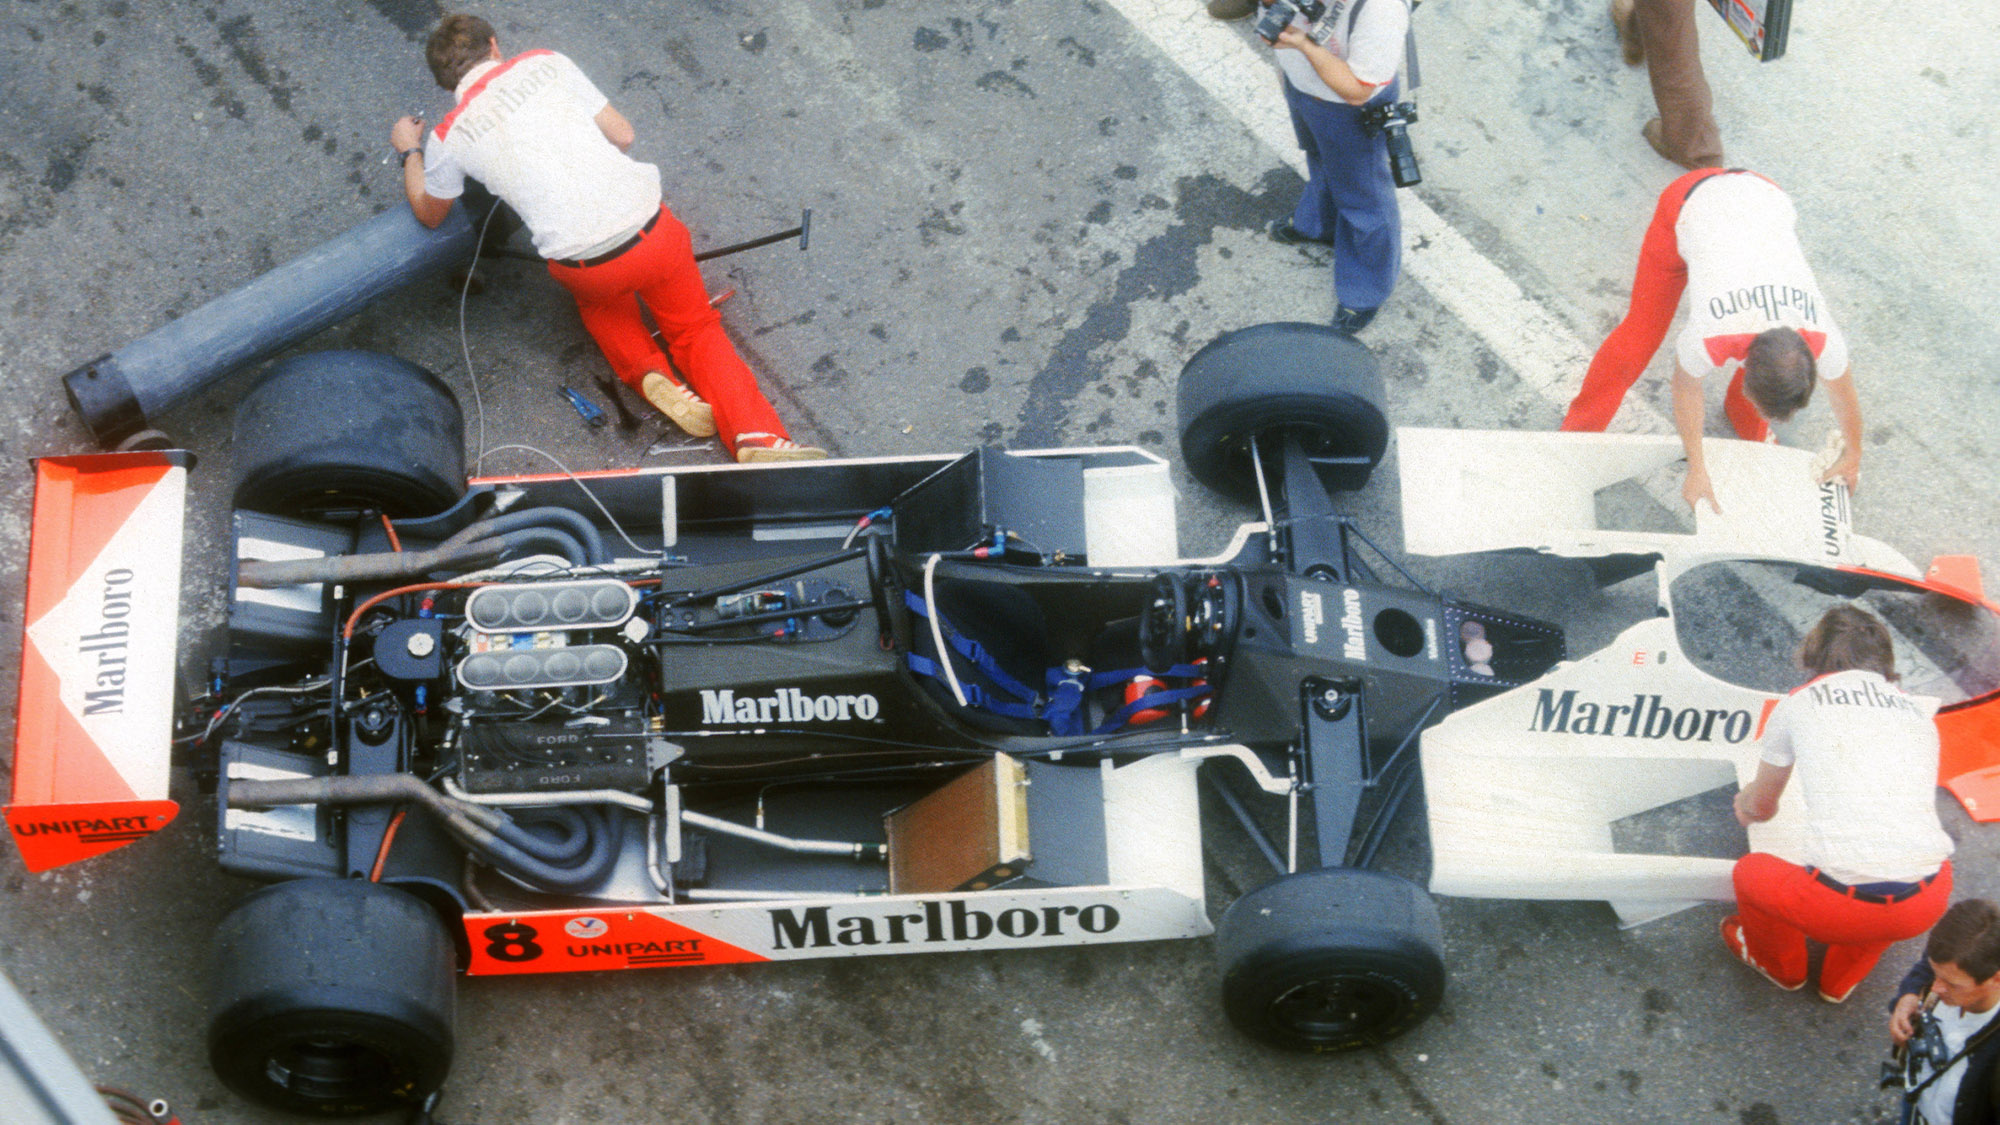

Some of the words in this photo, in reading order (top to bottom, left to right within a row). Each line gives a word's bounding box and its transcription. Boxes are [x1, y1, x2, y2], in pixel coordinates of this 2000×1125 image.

[1709, 285, 1817, 324] Marlboro
[1820, 480, 1840, 557] UNIPAR
[79, 568, 134, 718] Marlboro
[1341, 589, 1366, 661] Marlboro
[1633, 651, 1646, 665] E
[699, 687, 879, 725] Marlboro
[1528, 688, 1752, 744] Marlboro
[537, 734, 579, 745] FORD
[539, 774, 581, 785] FORD
[14, 816, 149, 836] UNIPART
[484, 922, 544, 962] 8
[766, 900, 1120, 950] Marlboro
[566, 939, 702, 958] UNIPART
